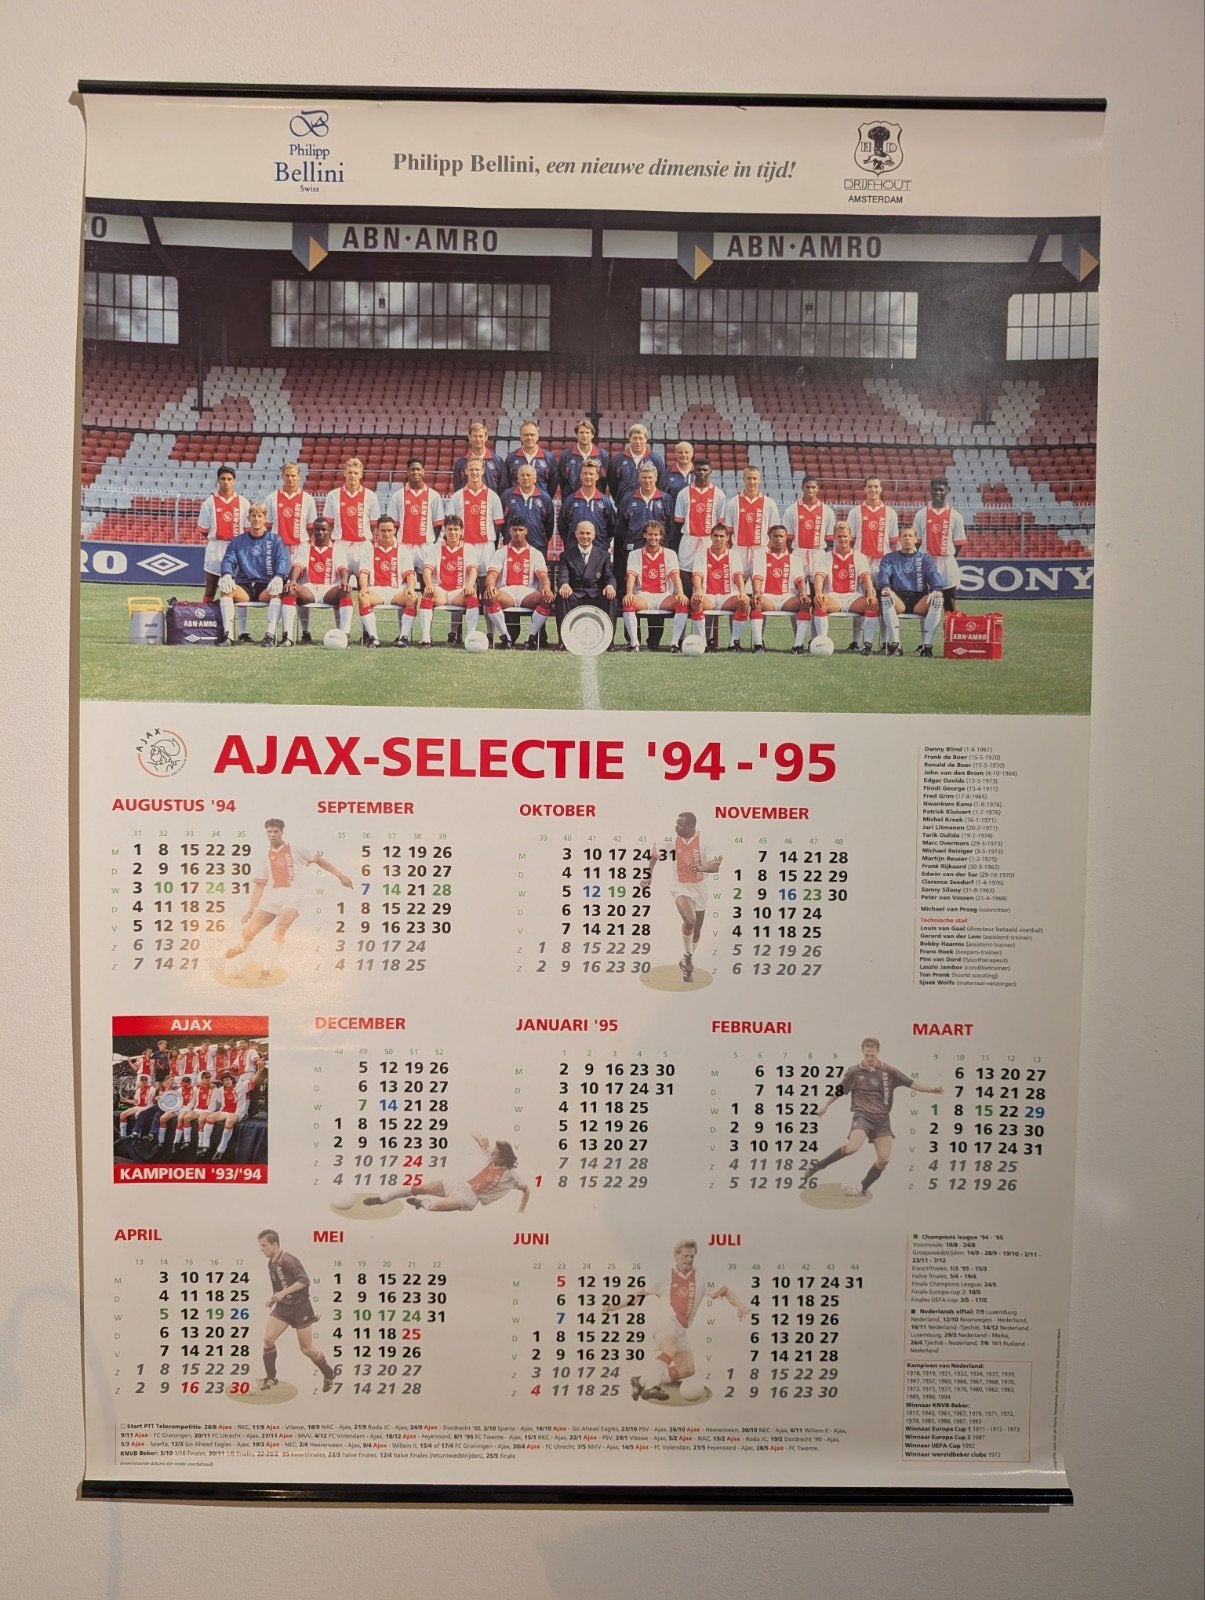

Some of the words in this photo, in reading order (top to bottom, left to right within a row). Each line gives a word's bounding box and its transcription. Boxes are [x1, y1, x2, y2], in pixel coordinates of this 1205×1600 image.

[289, 143, 330, 160] Philipp
[274, 161, 345, 183] Bellini
[393, 153, 463, 176] Philipp
[471, 155, 540, 176] Bellini,
[546, 160, 575, 174] een
[581, 157, 644, 175] nieuwe
[649, 158, 728, 178] dimensie
[733, 161, 751, 178] in
[757, 161, 796, 183] tijd!
[300, 185, 320, 193] Swiss
[848, 195, 903, 204] AMSTERDAM
[958, 565, 1094, 592] SONY
[136, 728, 161, 752] AJAX
[214, 734, 624, 780] AJAX-SELECTIE
[647, 741, 725, 781] '94
[112, 798, 205, 812] AUGUSTUS
[211, 799, 236, 813] '94
[317, 801, 414, 815] SEPTEMBER
[519, 804, 596, 817] OKTOBER
[715, 806, 809, 820] NOVEMBER
[133, 844, 141, 856] 1
[158, 844, 169, 856] 8
[180, 844, 200, 857] 15
[205, 844, 226, 857] 22
[231, 844, 252, 857] 29
[361, 846, 371, 858] 5
[382, 846, 402, 858] 12
[408, 846, 427, 859] 19
[432, 846, 453, 859] 26
[562, 886, 572, 898] 5
[582, 886, 601, 898] 12
[607, 886, 627, 899] 19
[632, 886, 652, 899] 26
[732, 888, 742, 900] 2
[757, 888, 767, 901] 9
[778, 889, 797, 901] 16
[802, 889, 822, 902] 23
[827, 889, 848, 902] 30
[170, 1019, 212, 1032] AJAX
[314, 1017, 406, 1031] DECEMBER
[515, 1019, 588, 1033] JANUARI
[594, 1019, 618, 1033] '95
[712, 1021, 792, 1034] FEBRUARI
[912, 1023, 973, 1036] MAART
[358, 1061, 368, 1074] 5
[379, 1062, 398, 1074] 12
[404, 1062, 424, 1075] 19
[429, 1062, 449, 1075] 26
[559, 1063, 569, 1076] 2
[584, 1063, 595, 1076] 9
[605, 1064, 624, 1076] 16
[629, 1064, 649, 1077] 23
[655, 1064, 676, 1077] 30
[954, 1067, 965, 1080] 6
[975, 1068, 995, 1080] 13
[1000, 1068, 1021, 1081] 20
[1025, 1069, 1047, 1082] 27
[731, 1103, 739, 1115] 1
[754, 1103, 765, 1116] 8
[775, 1103, 794, 1116] 15
[799, 1103, 821, 1117] 22
[120, 1167, 205, 1180] KAMPIOEN
[114, 1229, 162, 1242] APRIL
[313, 1230, 344, 1243] MEI
[513, 1232, 549, 1245] JUNI
[709, 1233, 741, 1247] JULI
[333, 1273, 341, 1285] 1
[357, 1273, 367, 1285] 8
[378, 1274, 397, 1286] 15
[402, 1274, 422, 1286] 22
[427, 1274, 447, 1286] 29
[556, 1276, 566, 1288] 5
[577, 1276, 596, 1288] 12
[602, 1276, 621, 1288] 19
[626, 1276, 646, 1289] 26
[751, 1277, 761, 1289] 3
[772, 1277, 791, 1289] 10
[796, 1277, 815, 1289] 17
[820, 1277, 840, 1289] 24
[845, 1277, 863, 1289] 31
[159, 1308, 169, 1321] 5
[180, 1308, 199, 1320] 12
[205, 1308, 225, 1321] 19
[230, 1308, 250, 1321] 26
